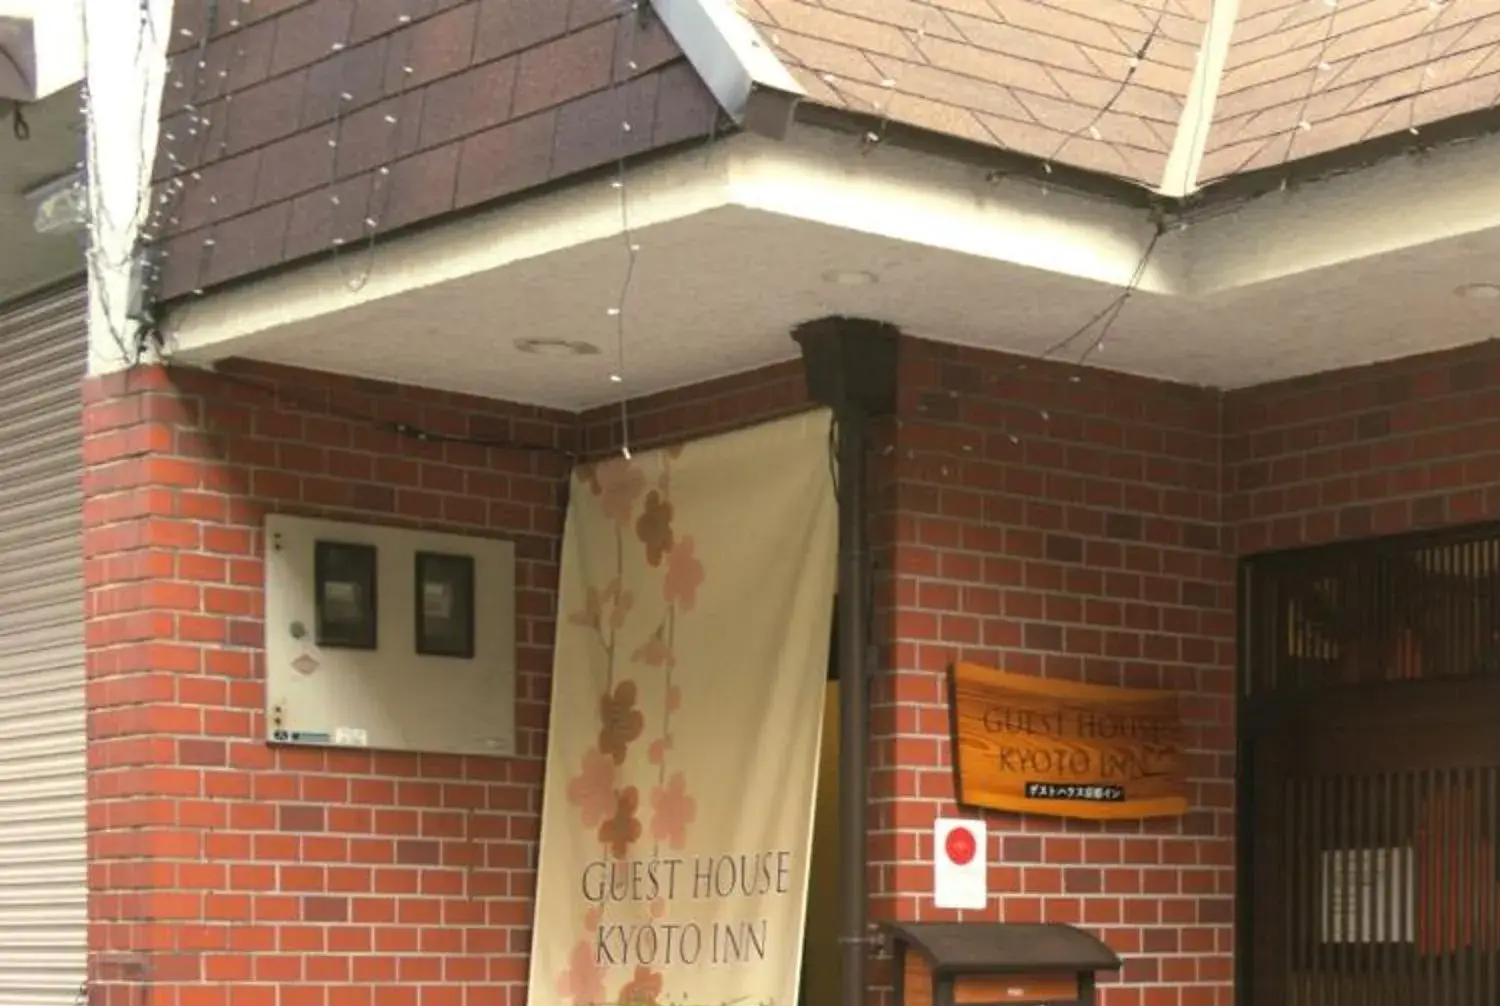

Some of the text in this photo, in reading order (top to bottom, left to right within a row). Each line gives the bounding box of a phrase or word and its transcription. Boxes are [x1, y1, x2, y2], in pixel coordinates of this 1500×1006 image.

[983, 706, 1063, 737] GUEST
[999, 746, 1091, 776] KYOTO
[582, 851, 791, 901] GUEST HOUSE
[595, 919, 768, 965] KYOTO INN
